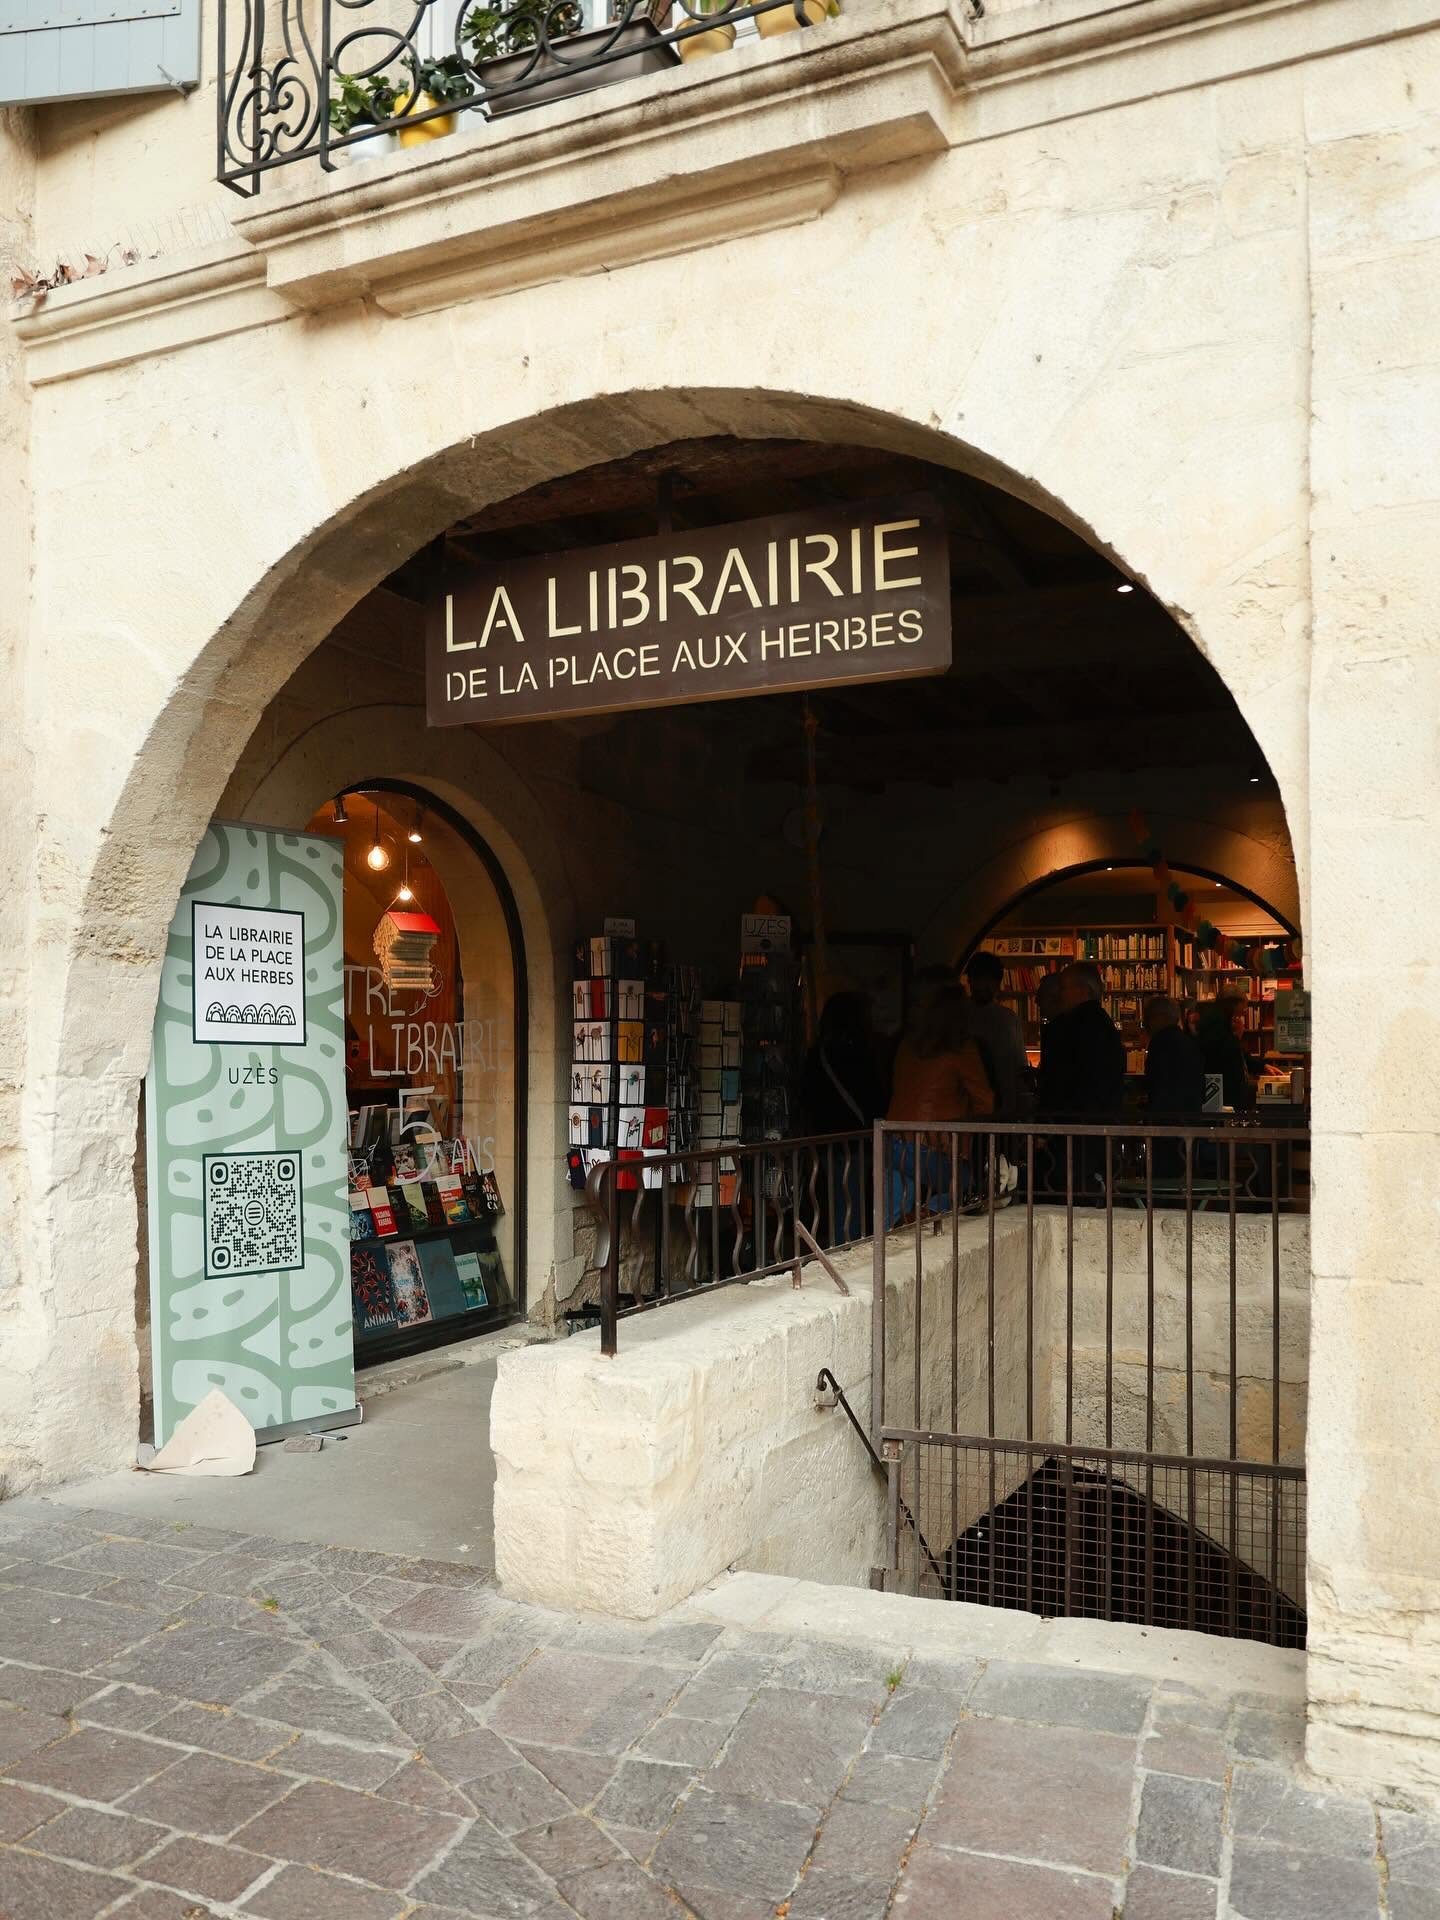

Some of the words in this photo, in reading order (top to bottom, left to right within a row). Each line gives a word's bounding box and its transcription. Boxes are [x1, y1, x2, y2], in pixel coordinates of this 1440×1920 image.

[446, 586, 525, 653] LA
[547, 518, 922, 638] LIBRAIRIE
[446, 667, 488, 702] DE
[499, 662, 538, 694] LA
[549, 643, 661, 689] PLACE
[672, 632, 748, 672] AUX
[760, 609, 924, 661] HERBES
[204, 924, 223, 940] LA
[229, 926, 293, 945] LIBRAIRIE
[205, 945, 225, 960] DE
[230, 947, 247, 962] LA
[251, 949, 293, 966] PLACE
[204, 967, 236, 983] AUX
[241, 968, 294, 986] HERBES
[369, 1019, 508, 1077] LIBRAIRIE
[228, 1062, 279, 1085] UZÈS
[364, 1312, 397, 1330] ANIMAL
